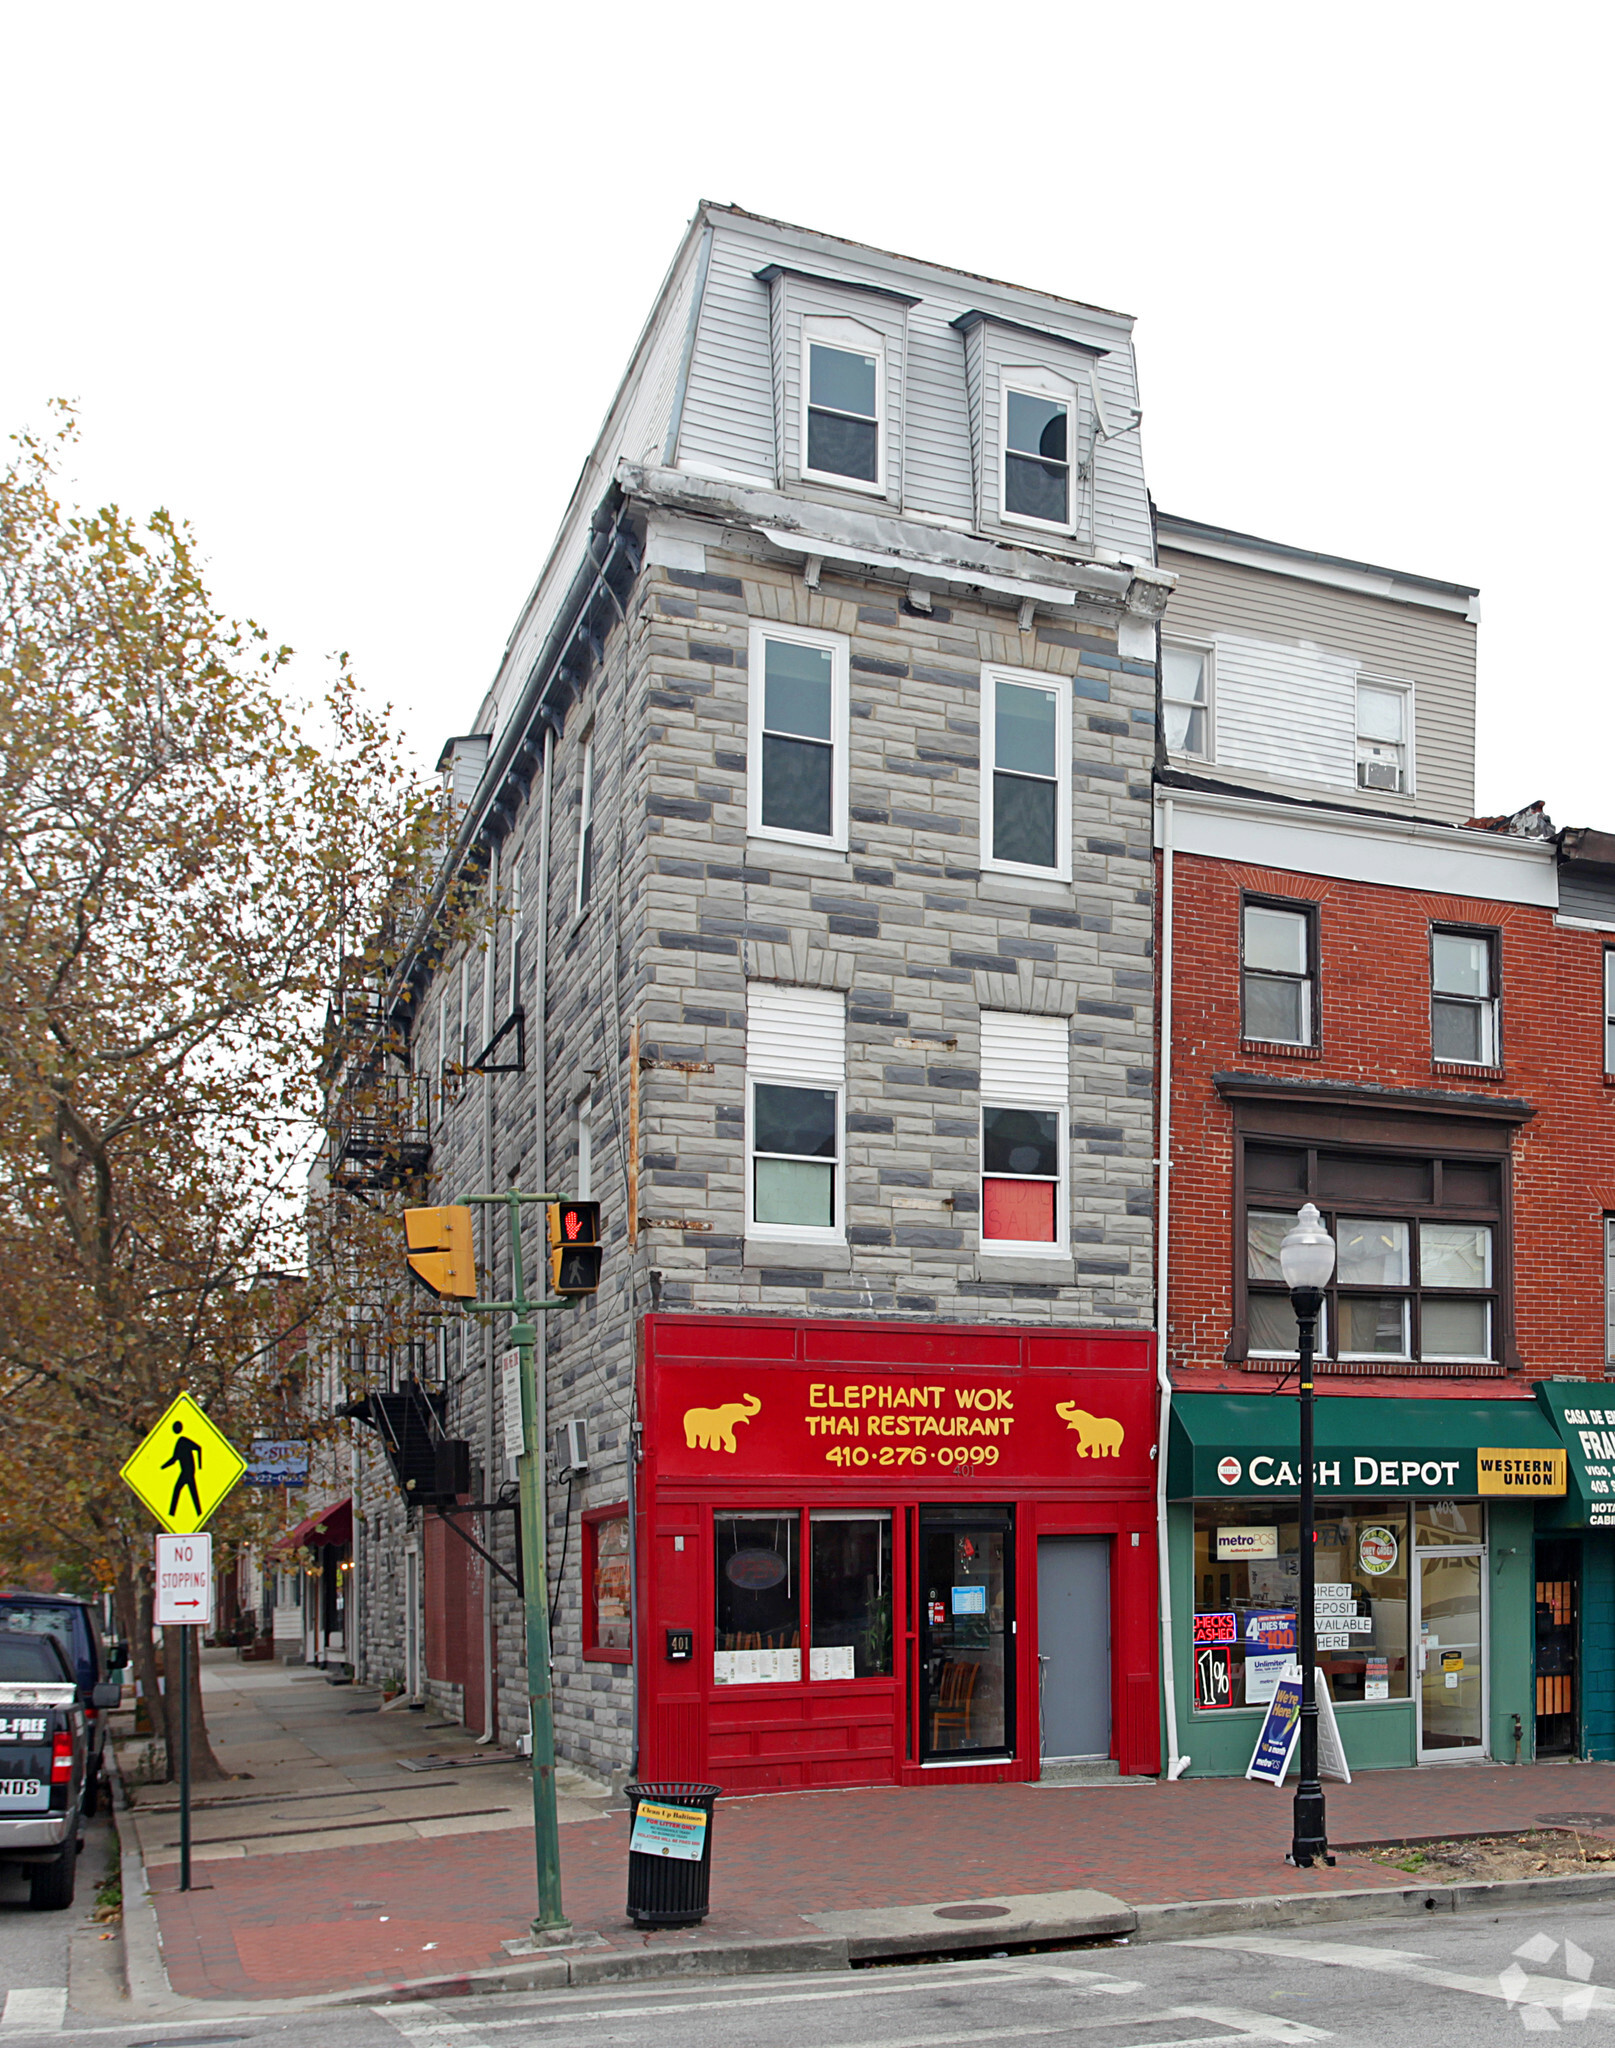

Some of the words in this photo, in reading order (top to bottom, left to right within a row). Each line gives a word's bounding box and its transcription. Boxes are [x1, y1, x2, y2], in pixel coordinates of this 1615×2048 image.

[984, 1180, 1052, 1206] BUILDING
[987, 1209, 1050, 1236] SALE
[810, 1384, 946, 1409] ELEPHANT
[955, 1388, 1015, 1411] WOK
[1564, 1409, 1590, 1425] CASA
[1589, 1410, 1605, 1425] DE
[805, 1415, 860, 1437] THAI
[867, 1415, 1015, 1437] RESTAURANT
[953, 1465, 976, 1478] 401
[1353, 1456, 1460, 1486] DEPOT
[1480, 1460, 1551, 1472] WESTERN
[1504, 1473, 1551, 1486] UNION
[1591, 1480, 1610, 1493] 405
[1436, 1501, 1455, 1515] 403
[1219, 1533, 1276, 1546] metroPCS
[1365, 1529, 1392, 1544] FREE
[174, 1546, 193, 1562] NO
[1377, 1546, 1393, 1556] ORDER
[162, 1572, 206, 1589] STOPPING
[1314, 1586, 1351, 1597] IRECT
[1315, 1602, 1356, 1614] EPOSIT
[1246, 1617, 1259, 1641] 4
[1258, 1621, 1278, 1631] LINES
[1315, 1619, 1371, 1630] VAILABLE
[1193, 1628, 1235, 1642] ASHED
[1259, 1629, 1294, 1650] $100
[1317, 1636, 1348, 1648] HERE
[671, 1637, 689, 1650] 401
[1198, 1649, 1230, 1705] 1%
[1276, 1689, 1299, 1705] We're
[642, 1806, 660, 1815] Clean
[662, 1810, 672, 1819] Up
[659, 1821, 680, 1829] LITTER
